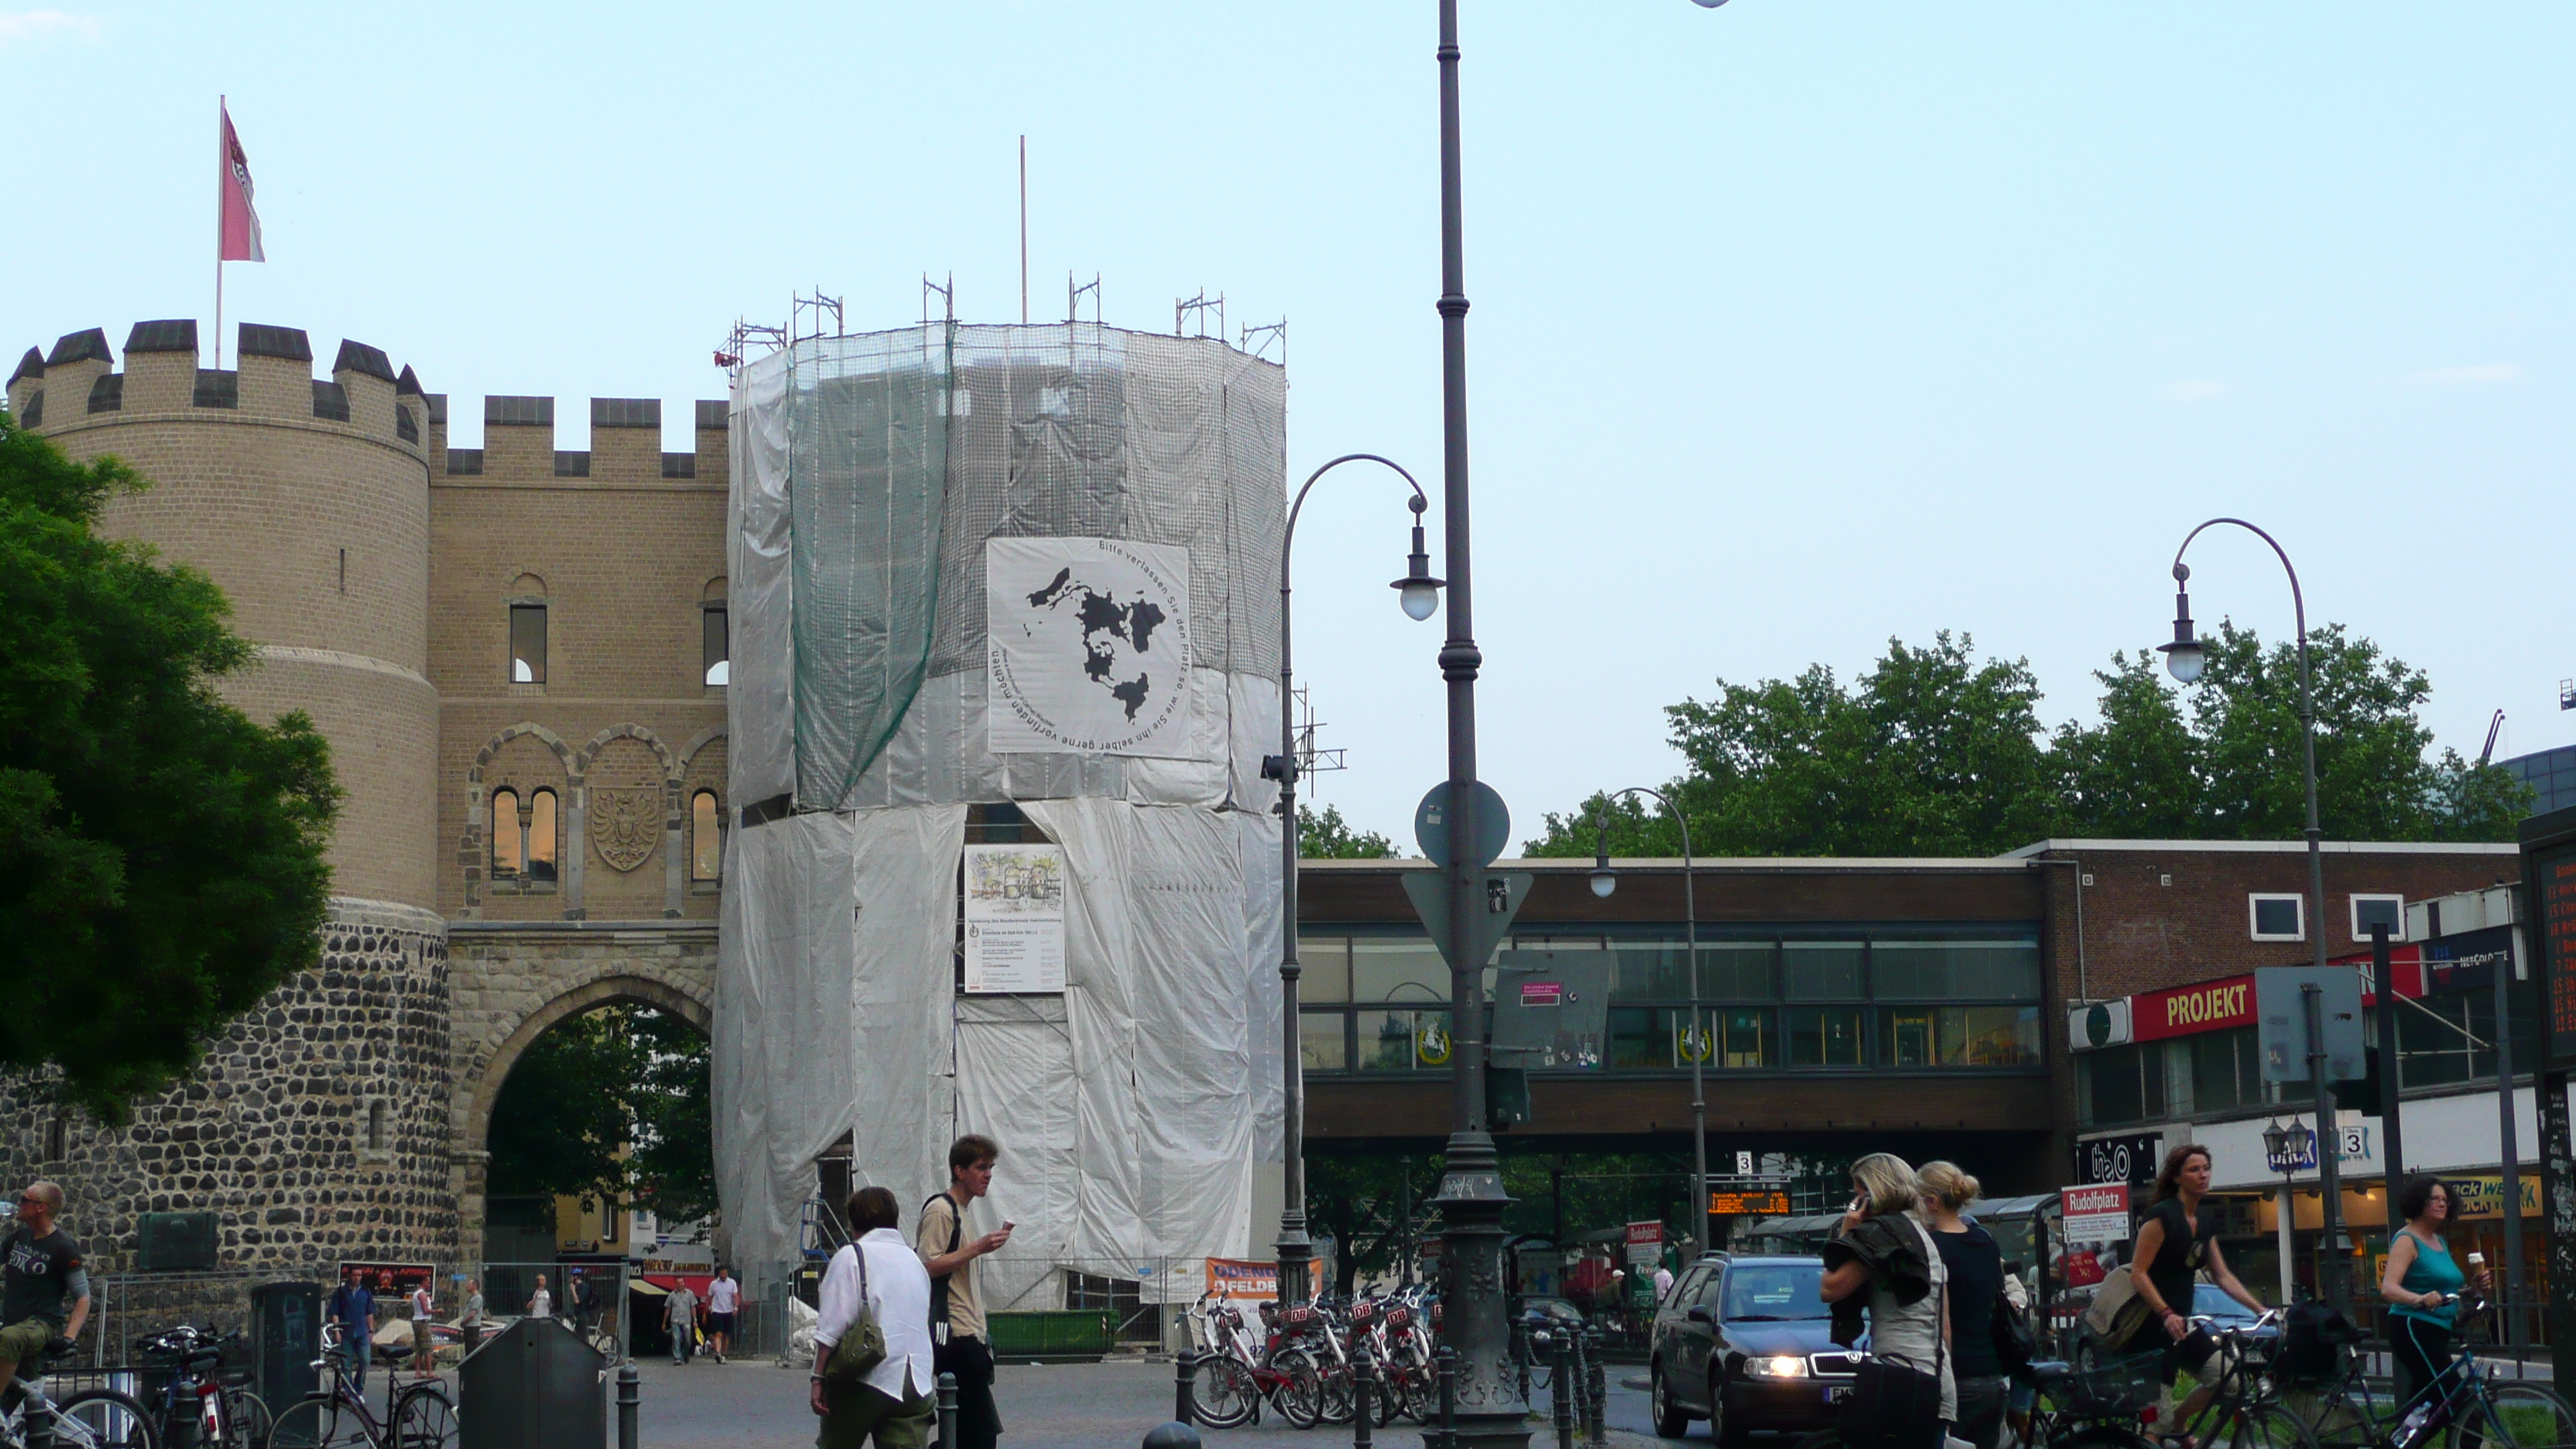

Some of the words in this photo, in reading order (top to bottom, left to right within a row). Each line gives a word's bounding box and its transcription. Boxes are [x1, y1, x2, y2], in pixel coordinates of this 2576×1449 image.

[1099, 540, 1122, 556] Bitte
[1125, 552, 1168, 594] verlassen
[1166, 596, 1179, 615] Sie
[1176, 618, 1186, 639] den
[1180, 644, 1190, 673] Platz
[1166, 696, 1179, 714] wie
[1011, 701, 1057, 741] vorfinden
[1153, 715, 1168, 730] Sie
[1061, 736, 1095, 750] gerne
[1136, 728, 1153, 742] ihn
[1100, 738, 1133, 752] selber
[2460, 950, 2509, 968] NETCOLOE
[2167, 984, 2246, 1026] PROJEKT
[2347, 1135, 2361, 1153] 3
[1740, 1157, 1749, 1170] 3
[2069, 1189, 2119, 1214] Rudolfplatz
[1292, 1309, 1307, 1321] DB
[1355, 1303, 1370, 1317] DB
[1389, 1310, 1406, 1323] DB
